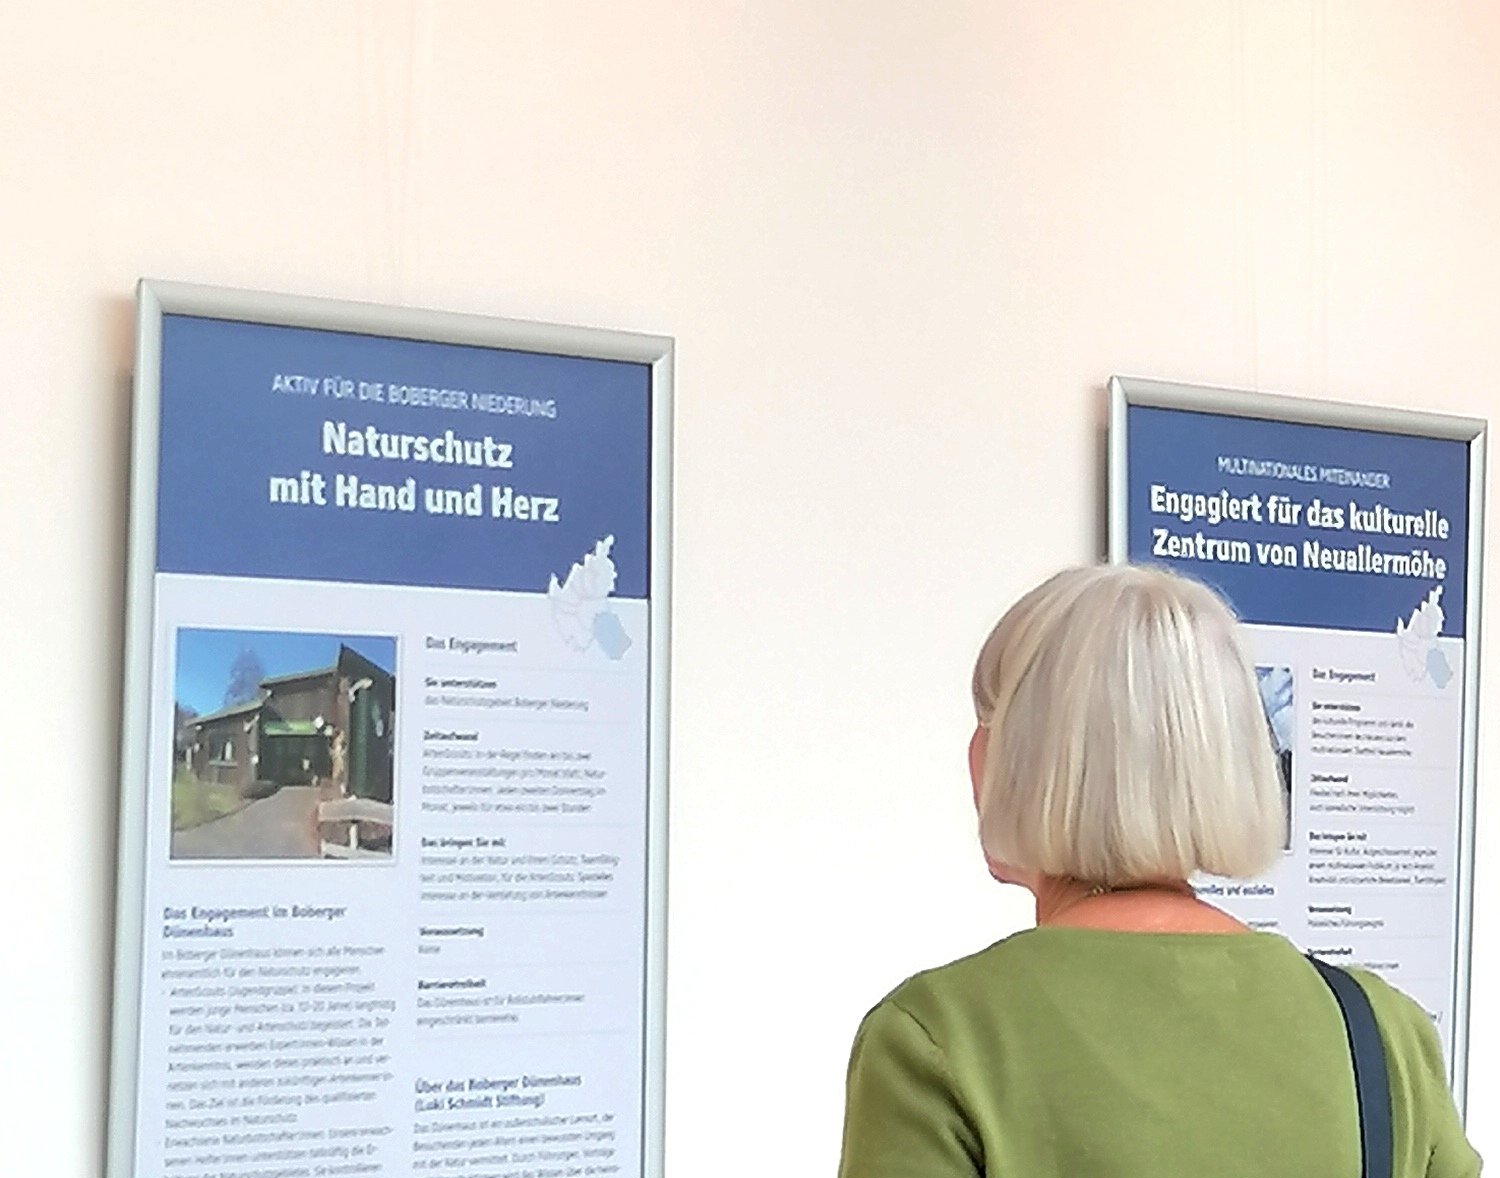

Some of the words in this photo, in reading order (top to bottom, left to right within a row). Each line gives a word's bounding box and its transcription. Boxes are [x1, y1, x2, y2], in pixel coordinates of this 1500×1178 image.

[271, 373, 319, 395] AKTIV
[323, 376, 354, 398] FÜR
[359, 381, 384, 401] DIE
[388, 384, 469, 410] BOBERGER
[471, 393, 557, 419] NIEDERUNG
[323, 422, 513, 468] Naturschutz
[269, 472, 326, 506] mit
[335, 474, 415, 511] Hand
[425, 485, 482, 516] und
[492, 487, 560, 522] Herz
[1150, 485, 1262, 524] Engagiert
[1267, 496, 1300, 525] für
[1307, 499, 1344, 530] das
[1350, 502, 1449, 540] kulturelle
[1153, 528, 1250, 563] Zentrum
[1257, 543, 1297, 567] von
[1303, 540, 1446, 580] Neuallermöhe
[164, 908, 186, 919] Das
[192, 907, 269, 922] Engagement
[273, 907, 287, 917] im
[292, 906, 346, 920] Boberger
